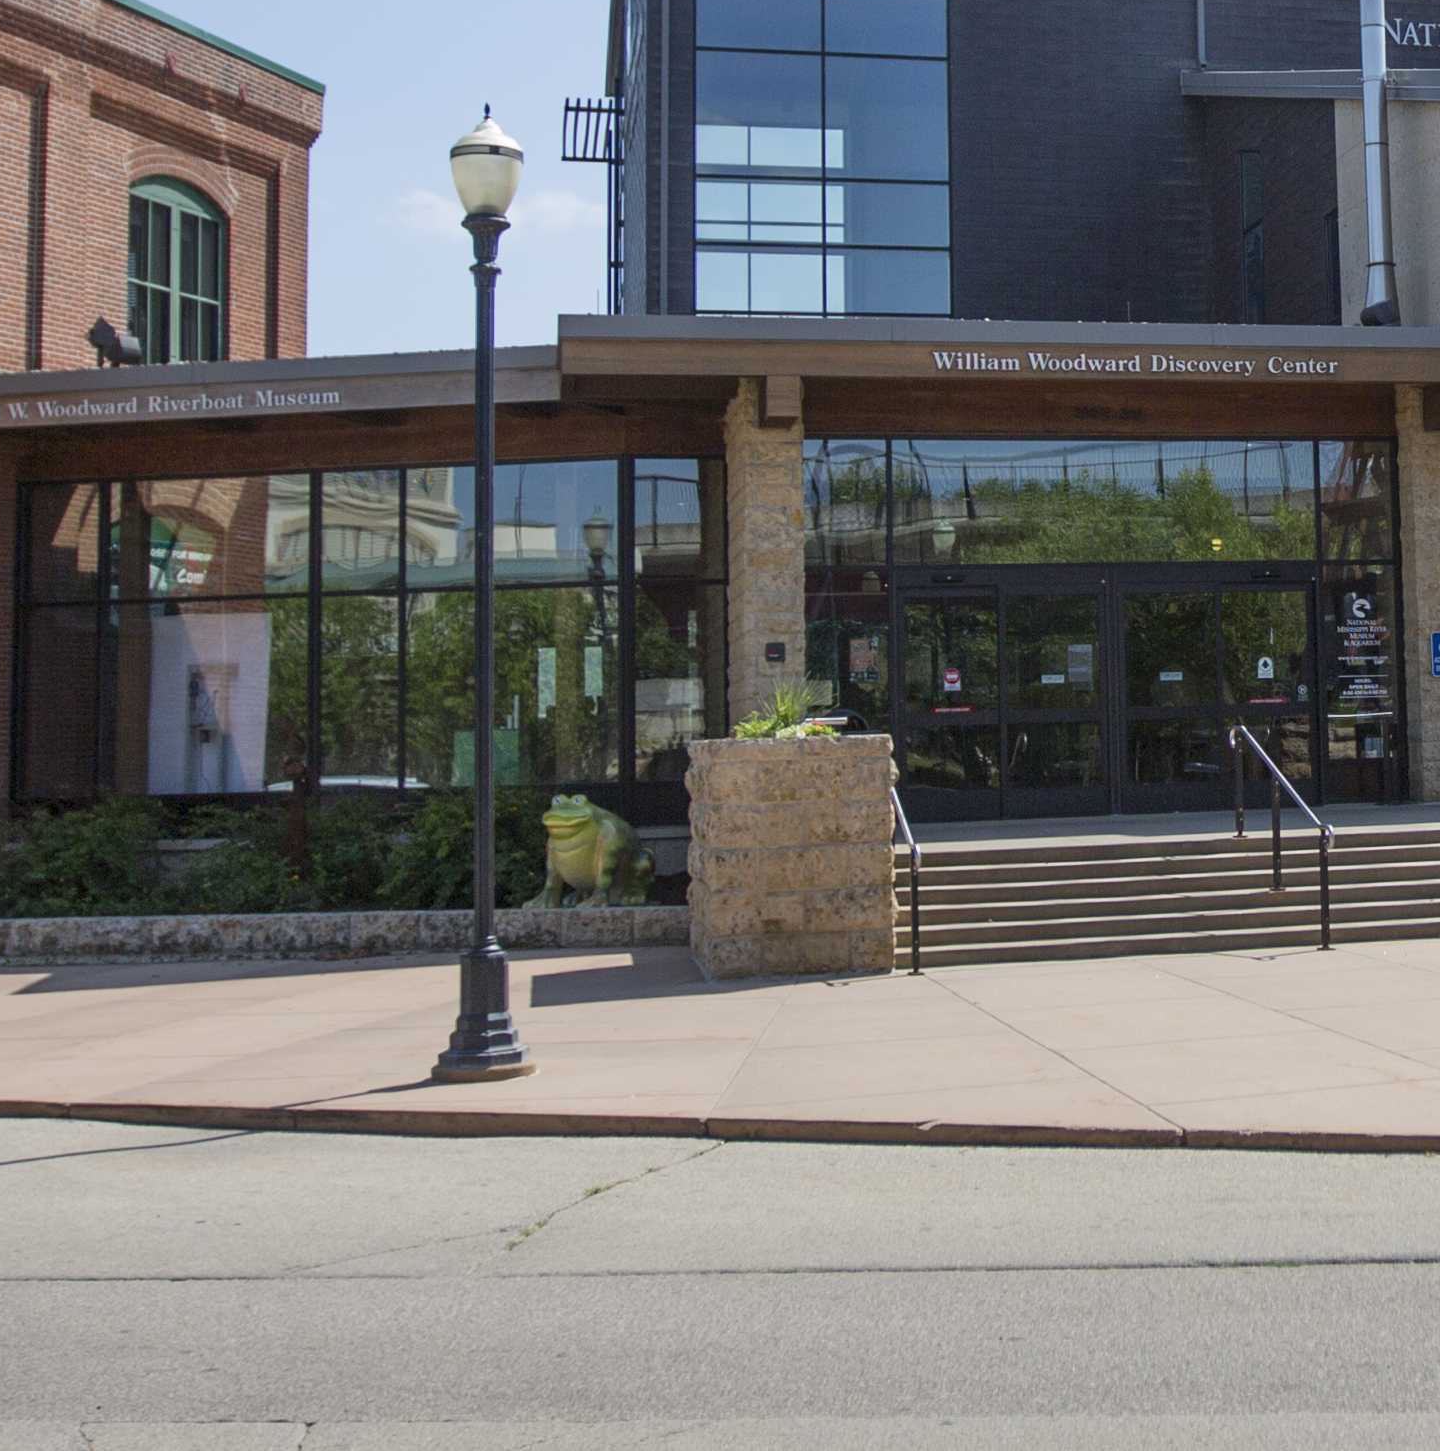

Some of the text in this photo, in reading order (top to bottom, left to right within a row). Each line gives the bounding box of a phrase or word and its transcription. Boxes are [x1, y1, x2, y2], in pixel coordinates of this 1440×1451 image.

[933, 351, 1339, 376] William Woodward Discovery Center
[8, 402, 30, 421] W.
[37, 397, 137, 419] Woodward
[148, 393, 244, 414] Riverboat
[256, 389, 341, 408] Museum
